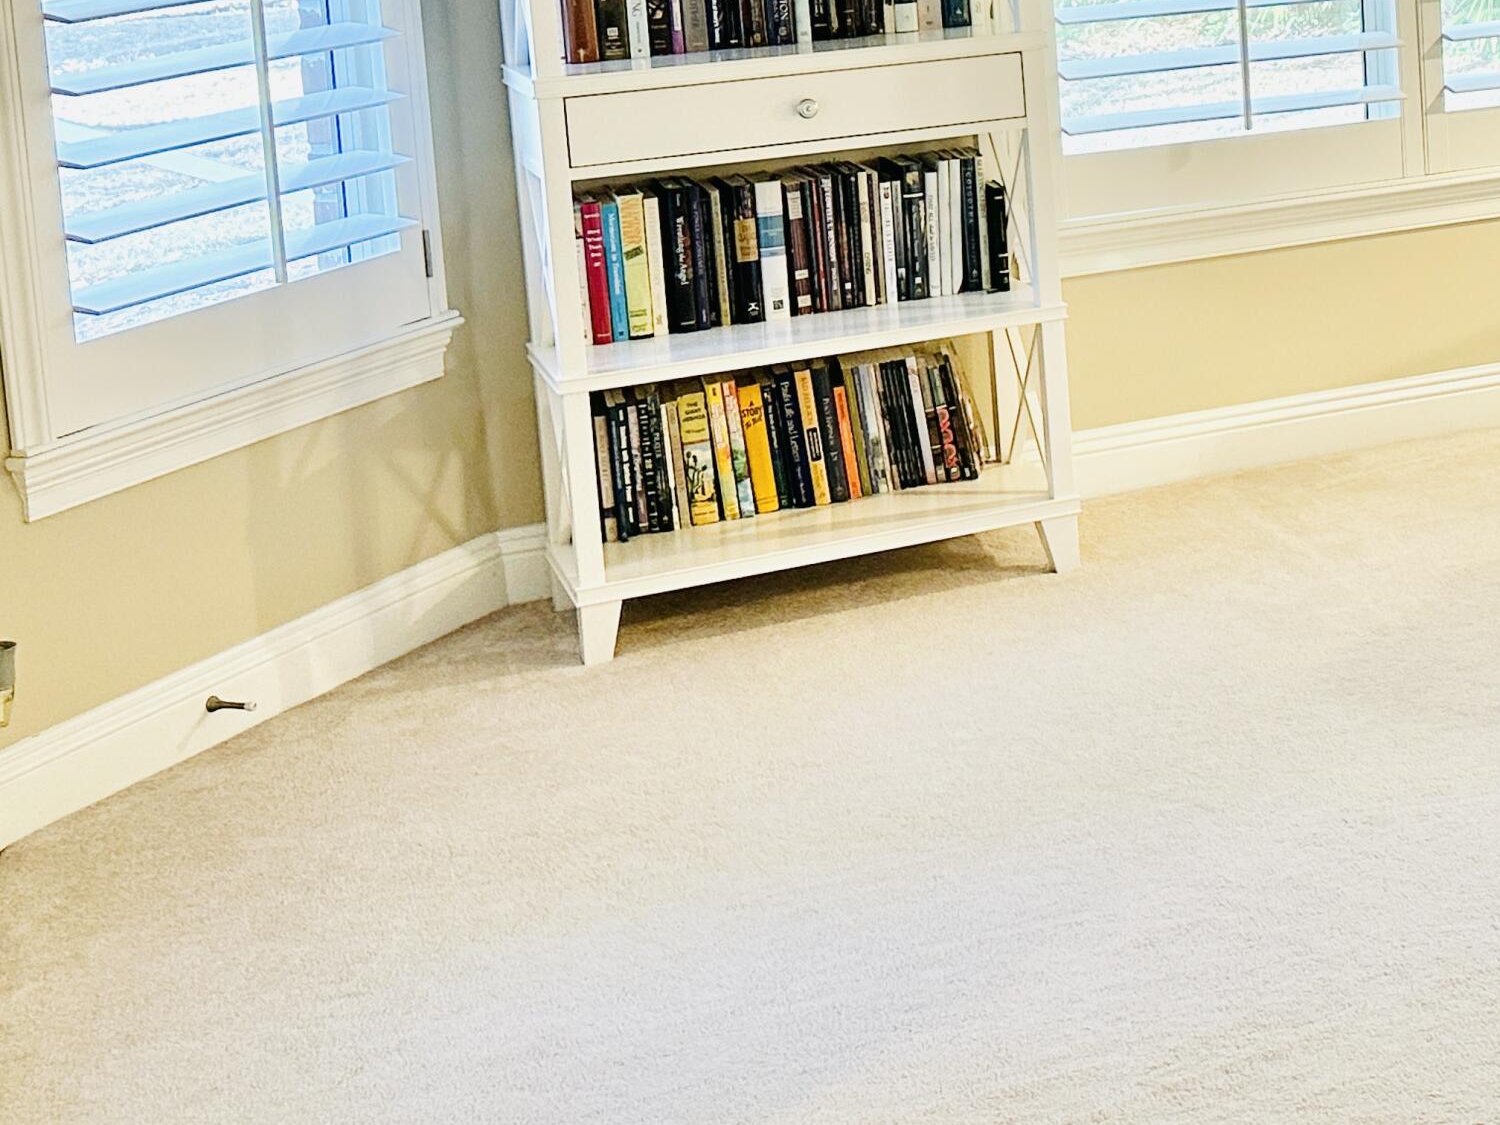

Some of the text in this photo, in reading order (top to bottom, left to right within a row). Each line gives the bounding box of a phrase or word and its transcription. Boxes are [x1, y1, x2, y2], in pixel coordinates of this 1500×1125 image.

[677, 263, 690, 286] Angel
[742, 407, 763, 418] STORY
[785, 403, 795, 419] Life
[787, 420, 799, 434] and
